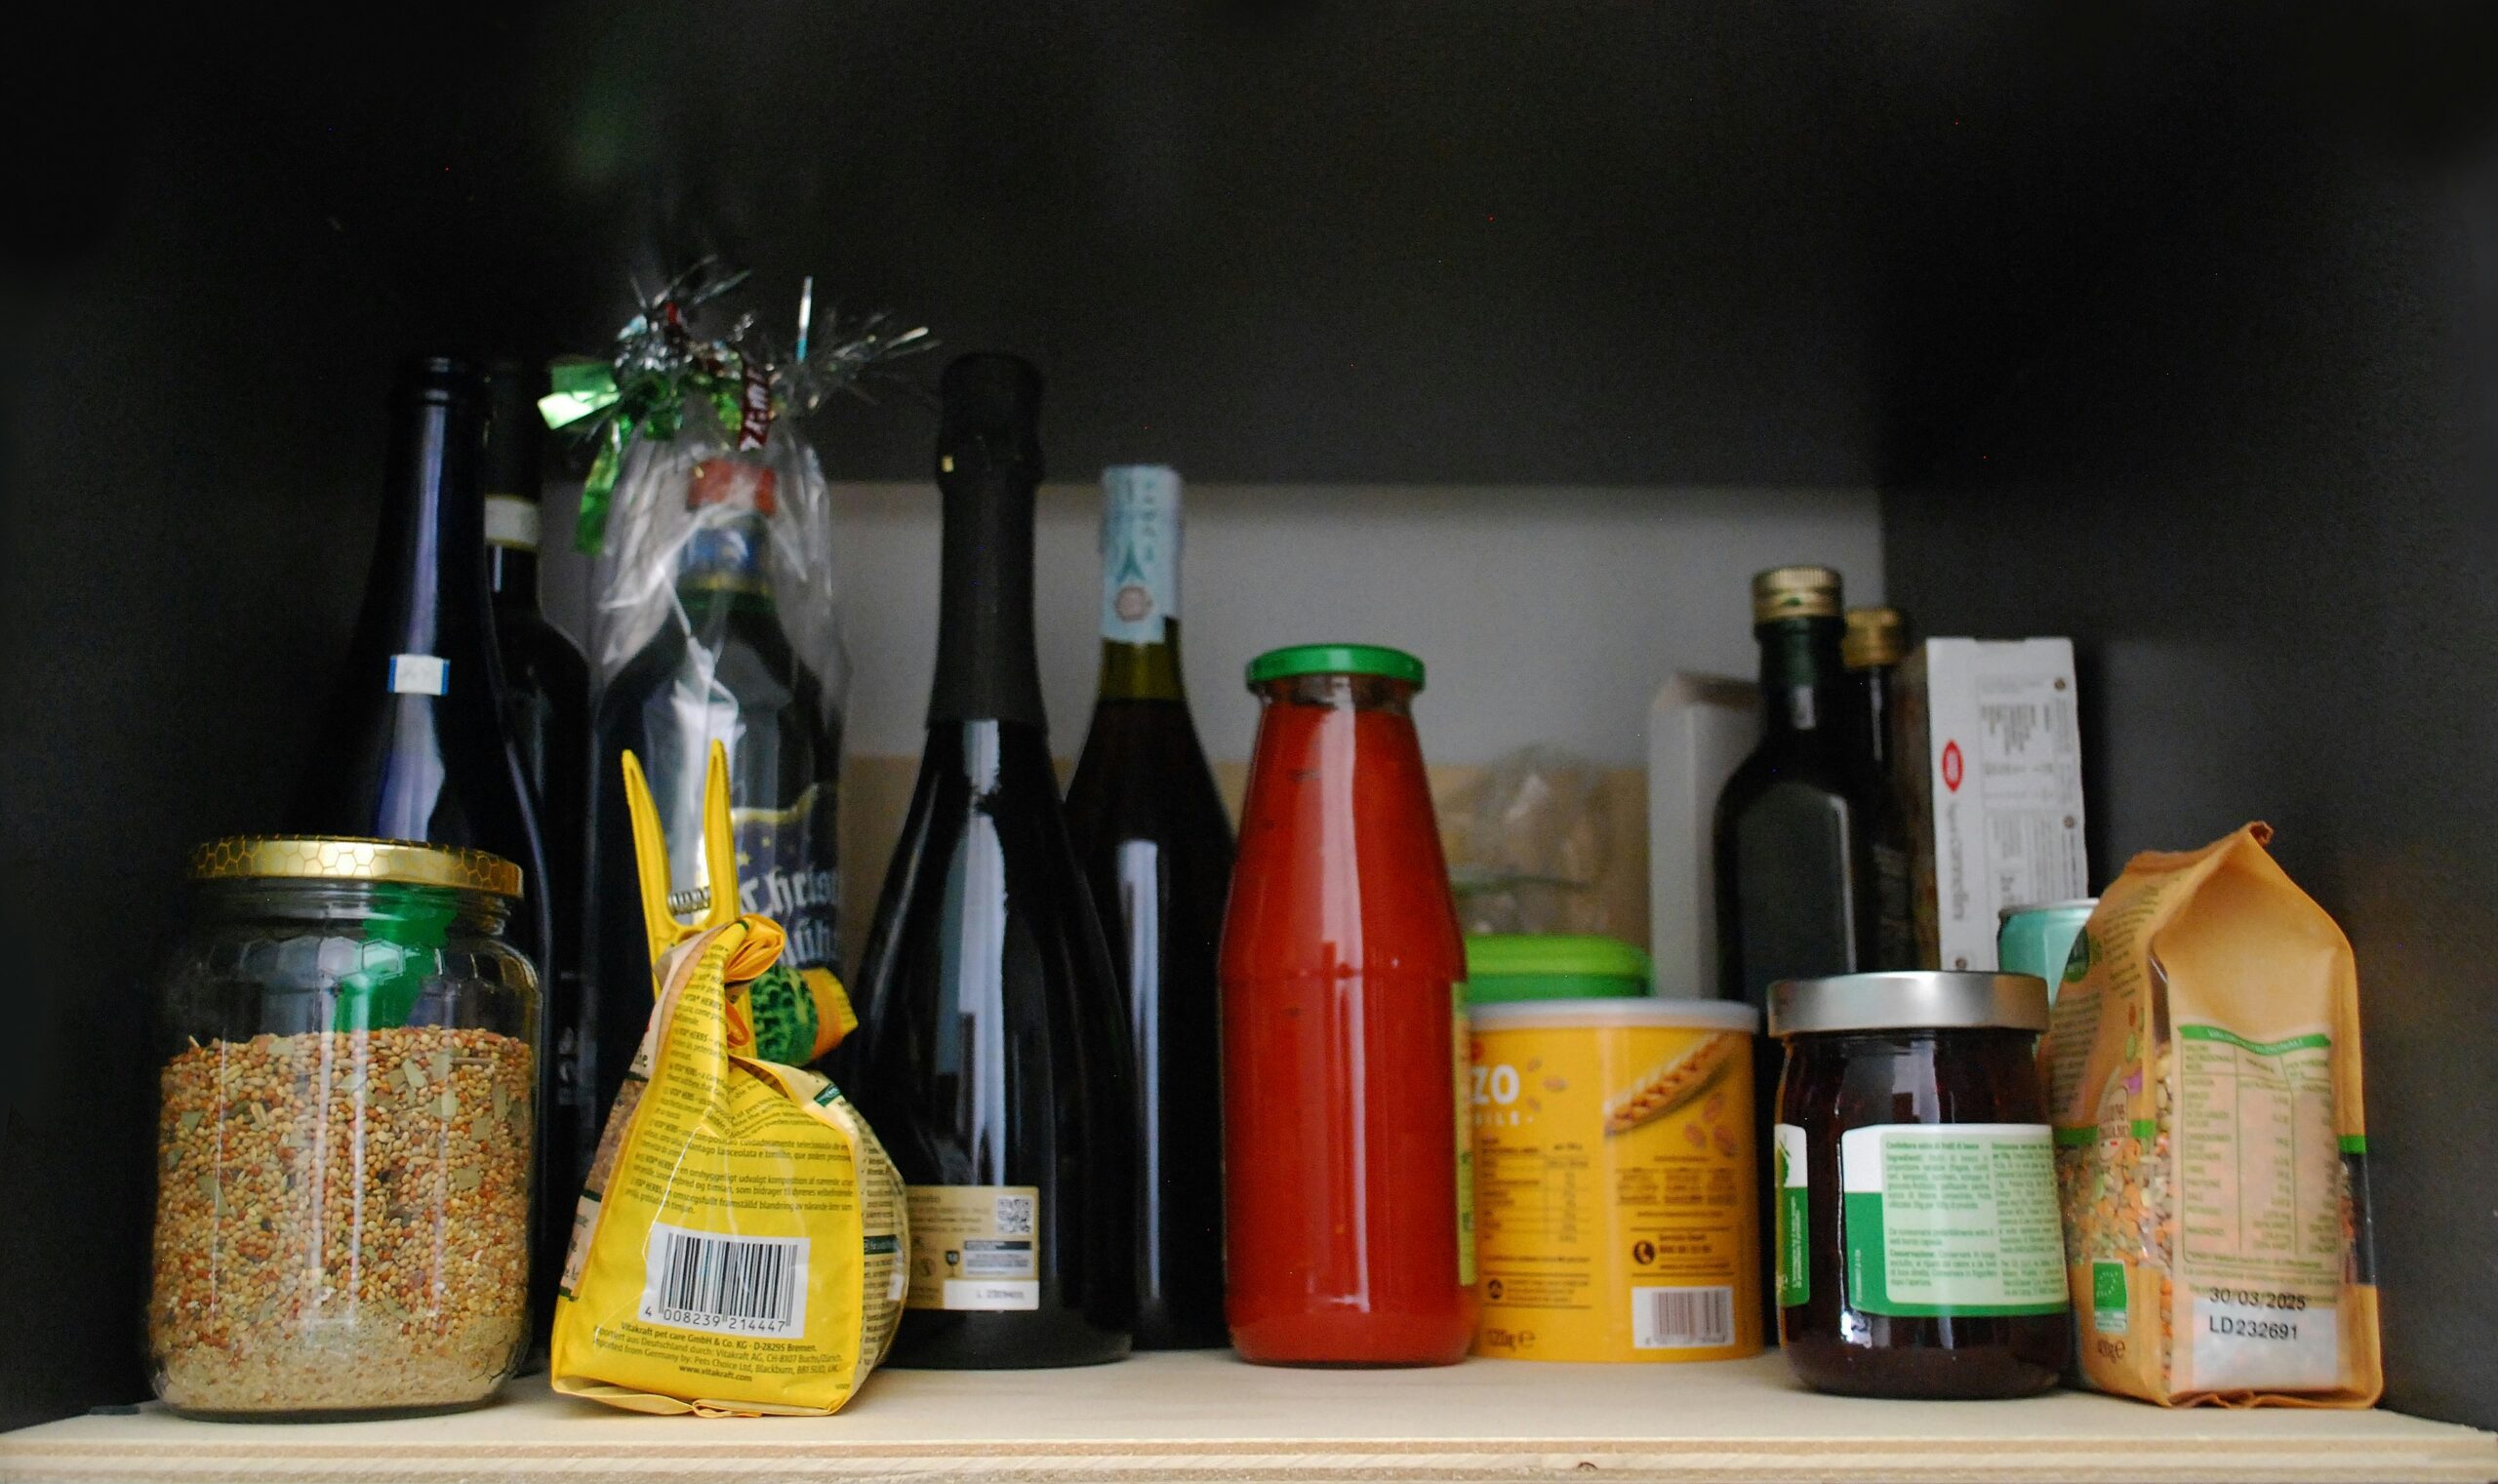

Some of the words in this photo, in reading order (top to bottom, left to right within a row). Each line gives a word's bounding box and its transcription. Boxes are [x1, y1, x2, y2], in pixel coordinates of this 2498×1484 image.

[644, 1305, 654, 1318] 4
[663, 1307, 720, 1327] 008239
[728, 1316, 786, 1333] 214447
[2209, 1314, 2299, 1341] LD232691
[621, 1321, 653, 1337] Vitakraft
[654, 1330, 668, 1341] pet
[669, 1332, 686, 1342] care
[687, 1334, 712, 1344] GmbH
[713, 1337, 721, 1346] &
[722, 1339, 735, 1348] Co.
[736, 1341, 747, 1349] KG
[678, 1364, 753, 1383] www.vitakraft.com
